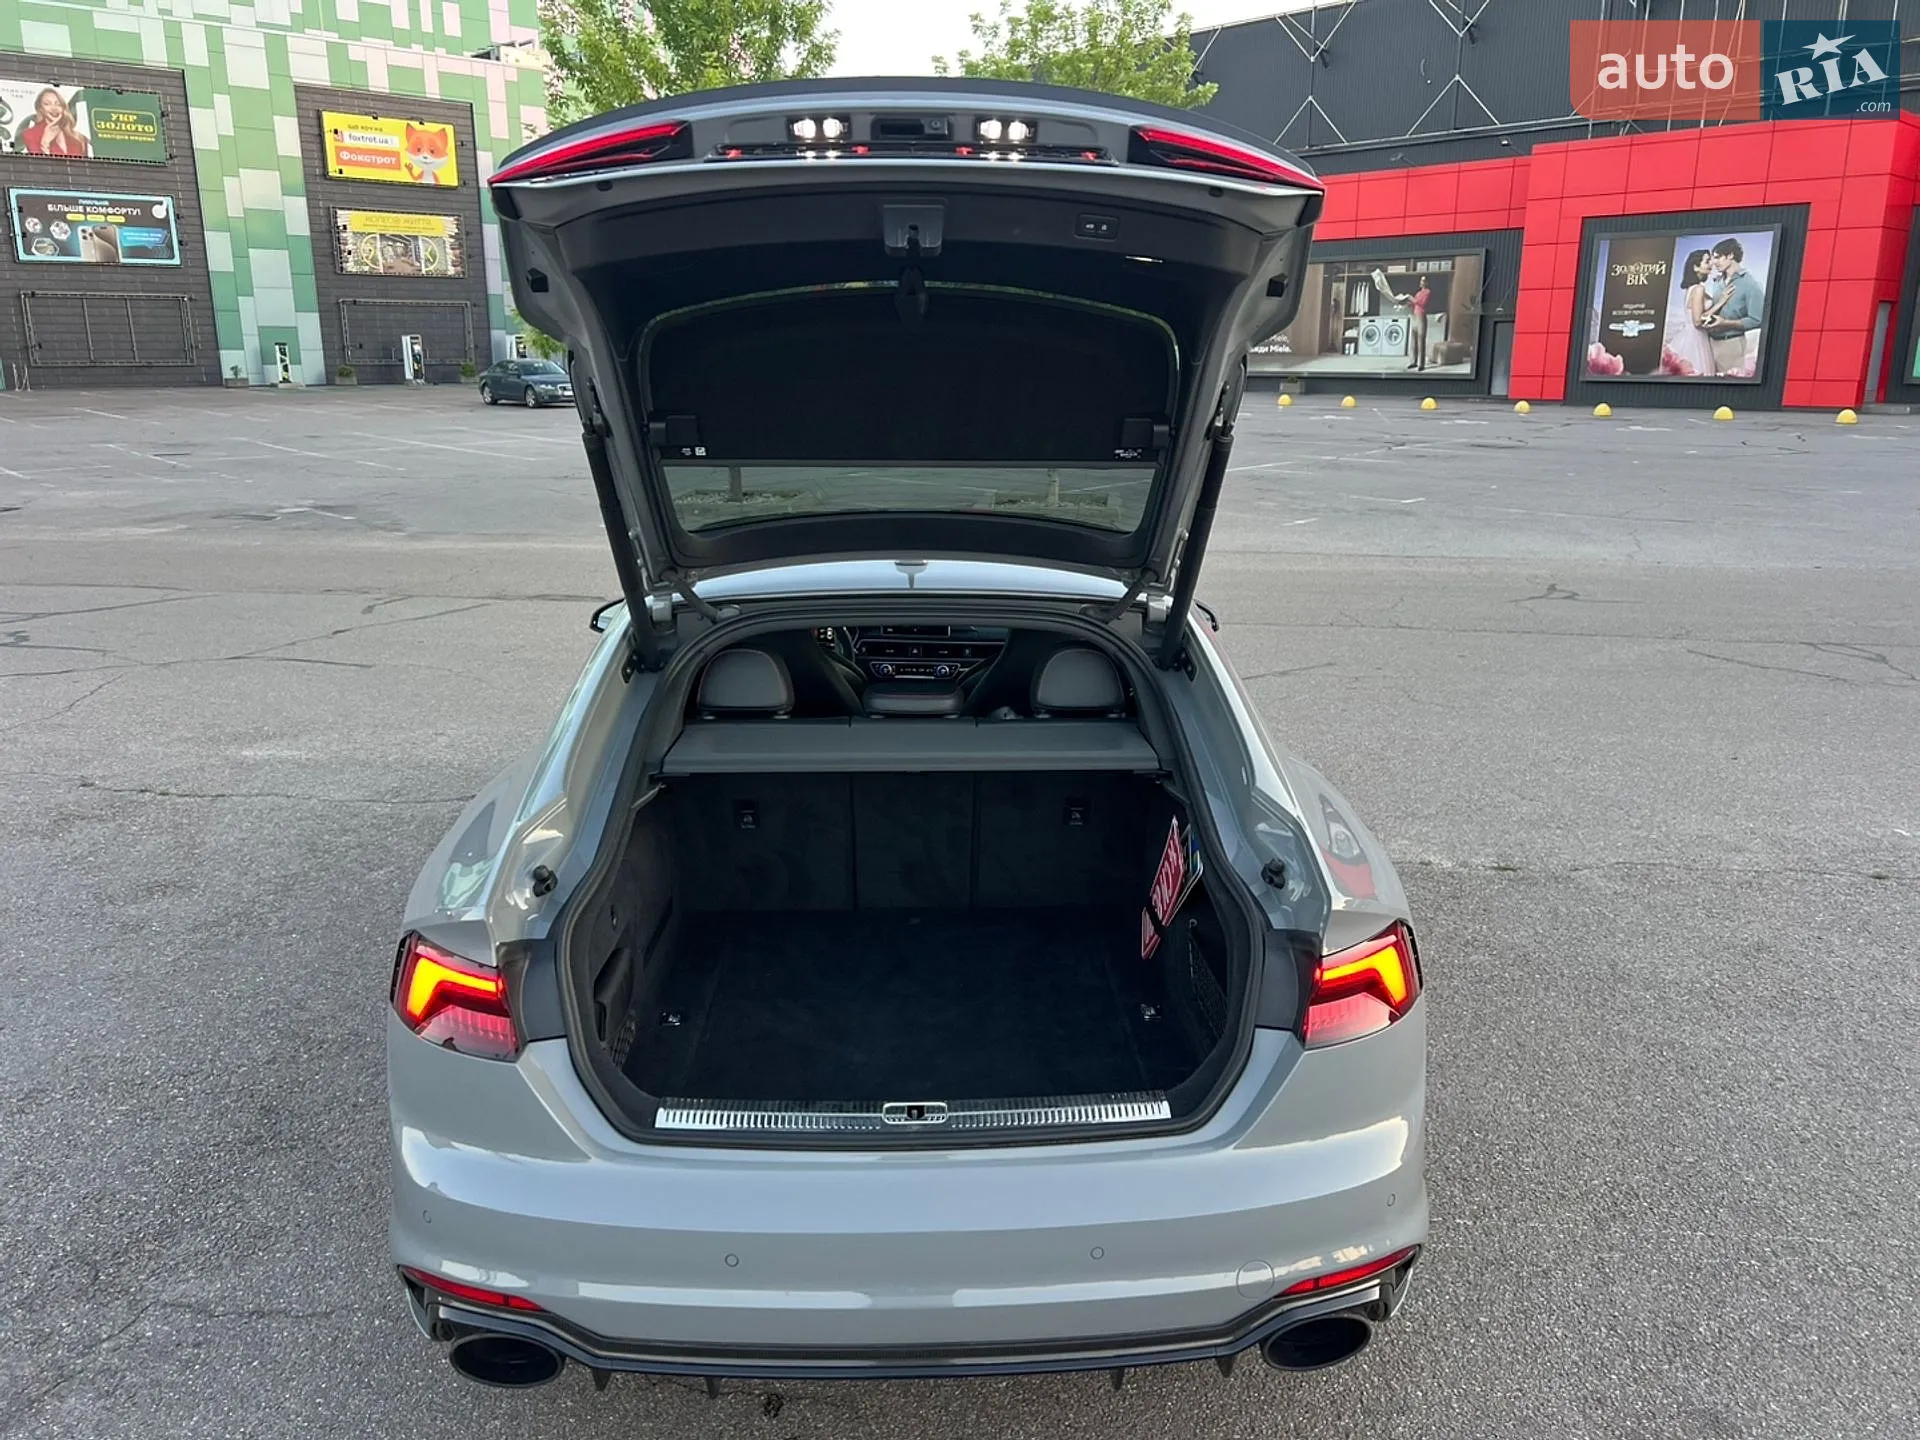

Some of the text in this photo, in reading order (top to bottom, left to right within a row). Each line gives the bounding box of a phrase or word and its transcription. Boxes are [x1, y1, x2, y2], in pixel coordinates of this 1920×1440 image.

[111, 113, 138, 122] УКР
[96, 121, 154, 132] ЗОЛОТО
[47, 203, 85, 213] БІЛЬШЕ
[1627, 273, 1648, 285] ВІК
